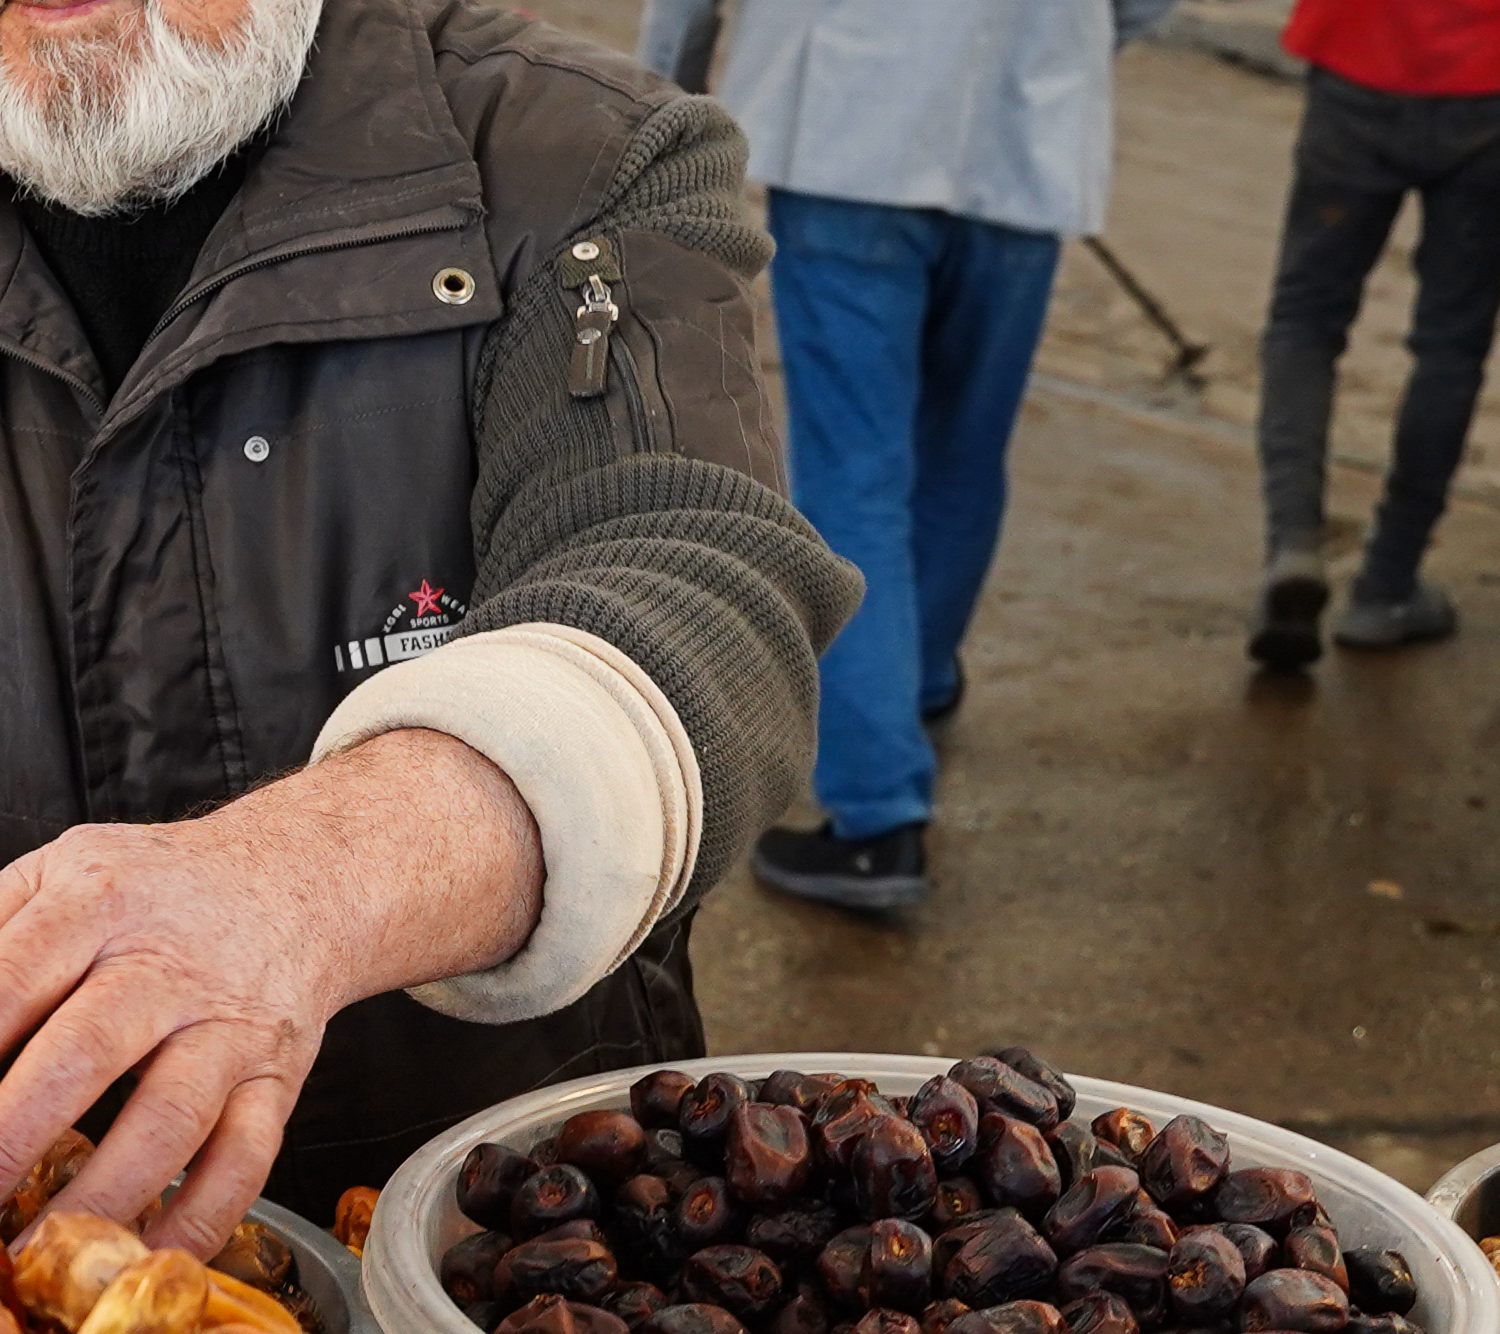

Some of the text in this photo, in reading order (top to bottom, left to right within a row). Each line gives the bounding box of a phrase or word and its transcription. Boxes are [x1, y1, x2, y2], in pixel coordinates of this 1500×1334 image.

[441, 593, 466, 615] WEA
[409, 614, 450, 629] SPORTS
[399, 632, 447, 653] FASH
